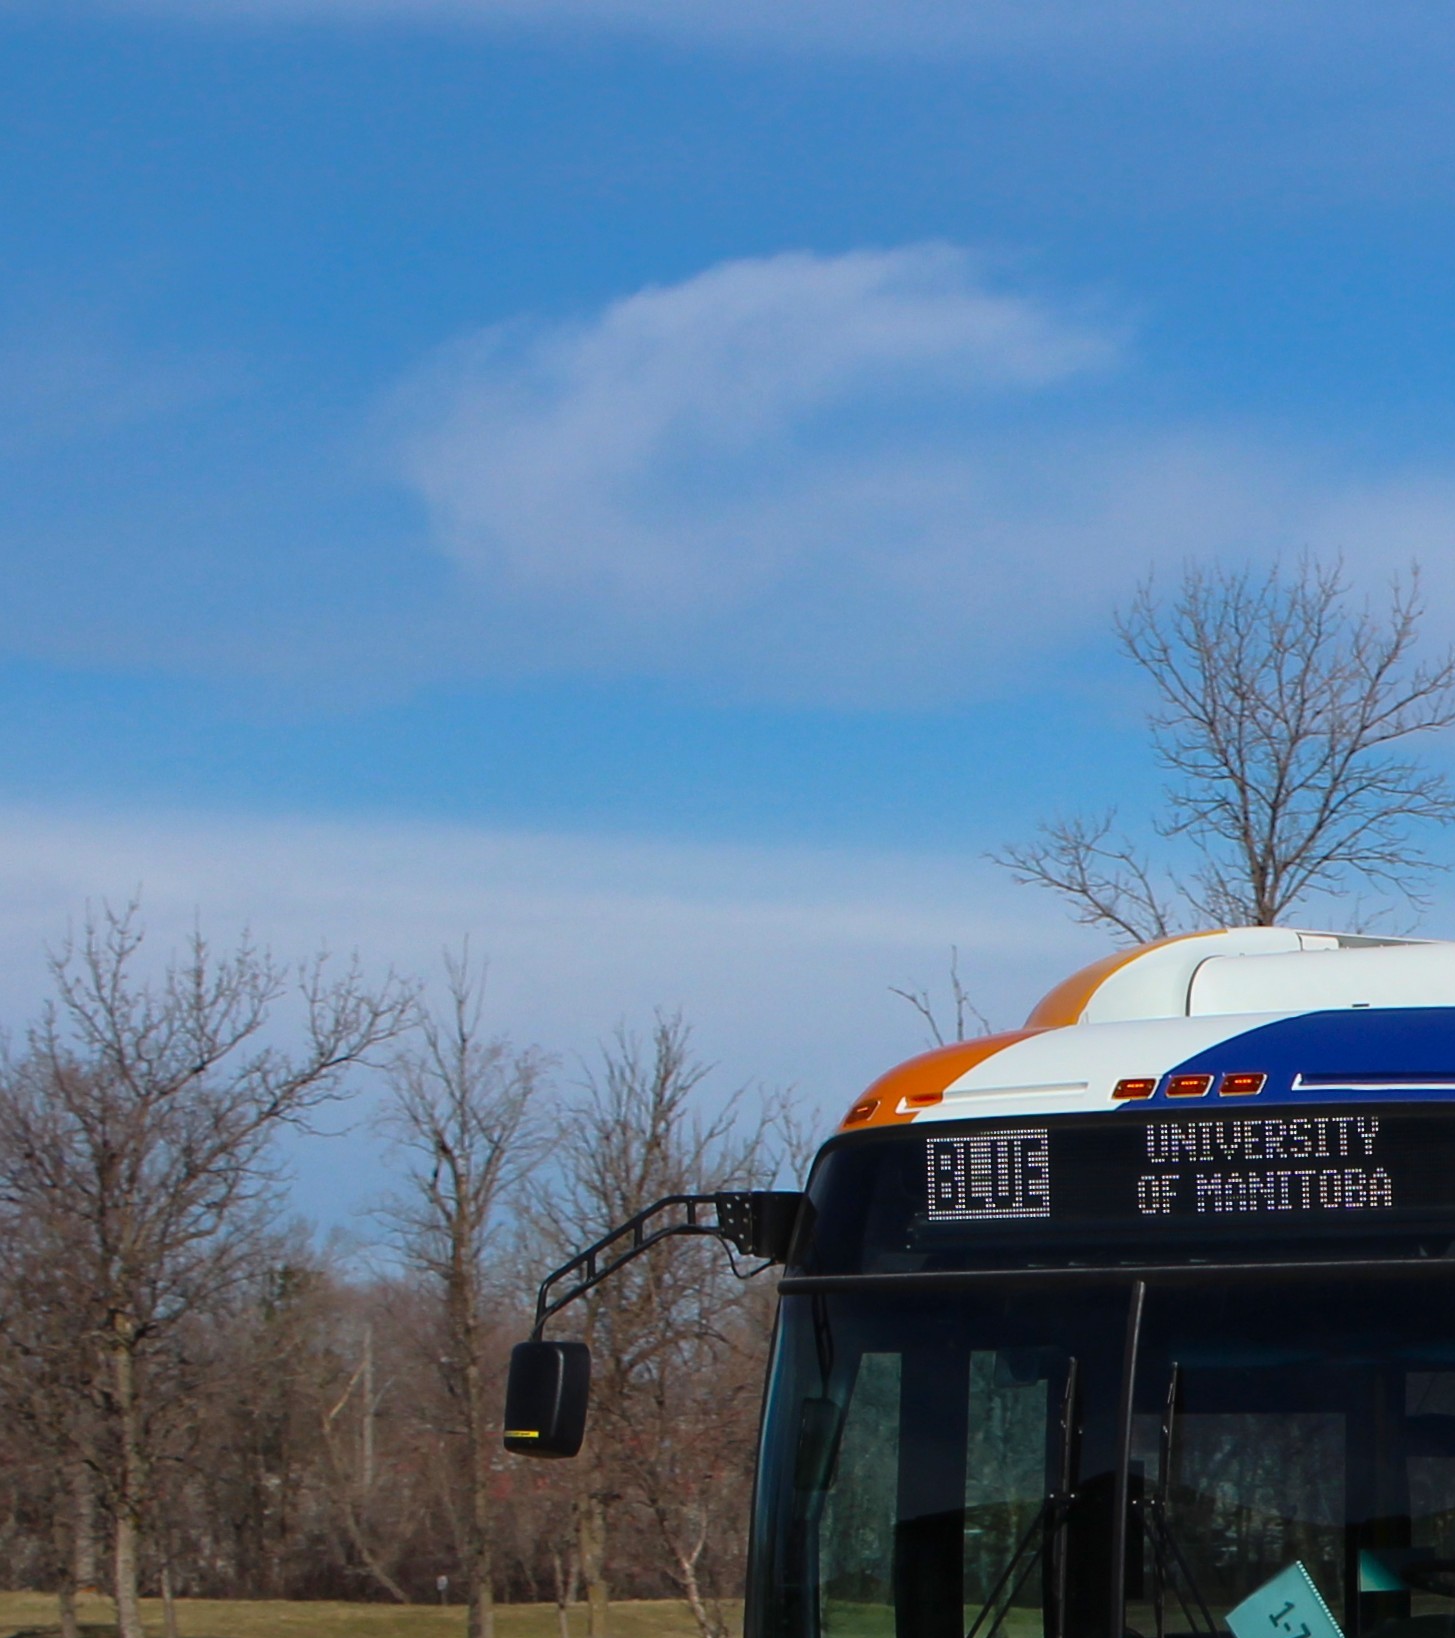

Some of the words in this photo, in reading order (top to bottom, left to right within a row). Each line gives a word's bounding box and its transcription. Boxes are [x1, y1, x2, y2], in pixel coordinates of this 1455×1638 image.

[1146, 1116, 1379, 1163] UNIVERSITY
[931, 1137, 1047, 1213] BLUE
[1138, 1174, 1180, 1214] OF
[1196, 1168, 1393, 1212] MANITOBA
